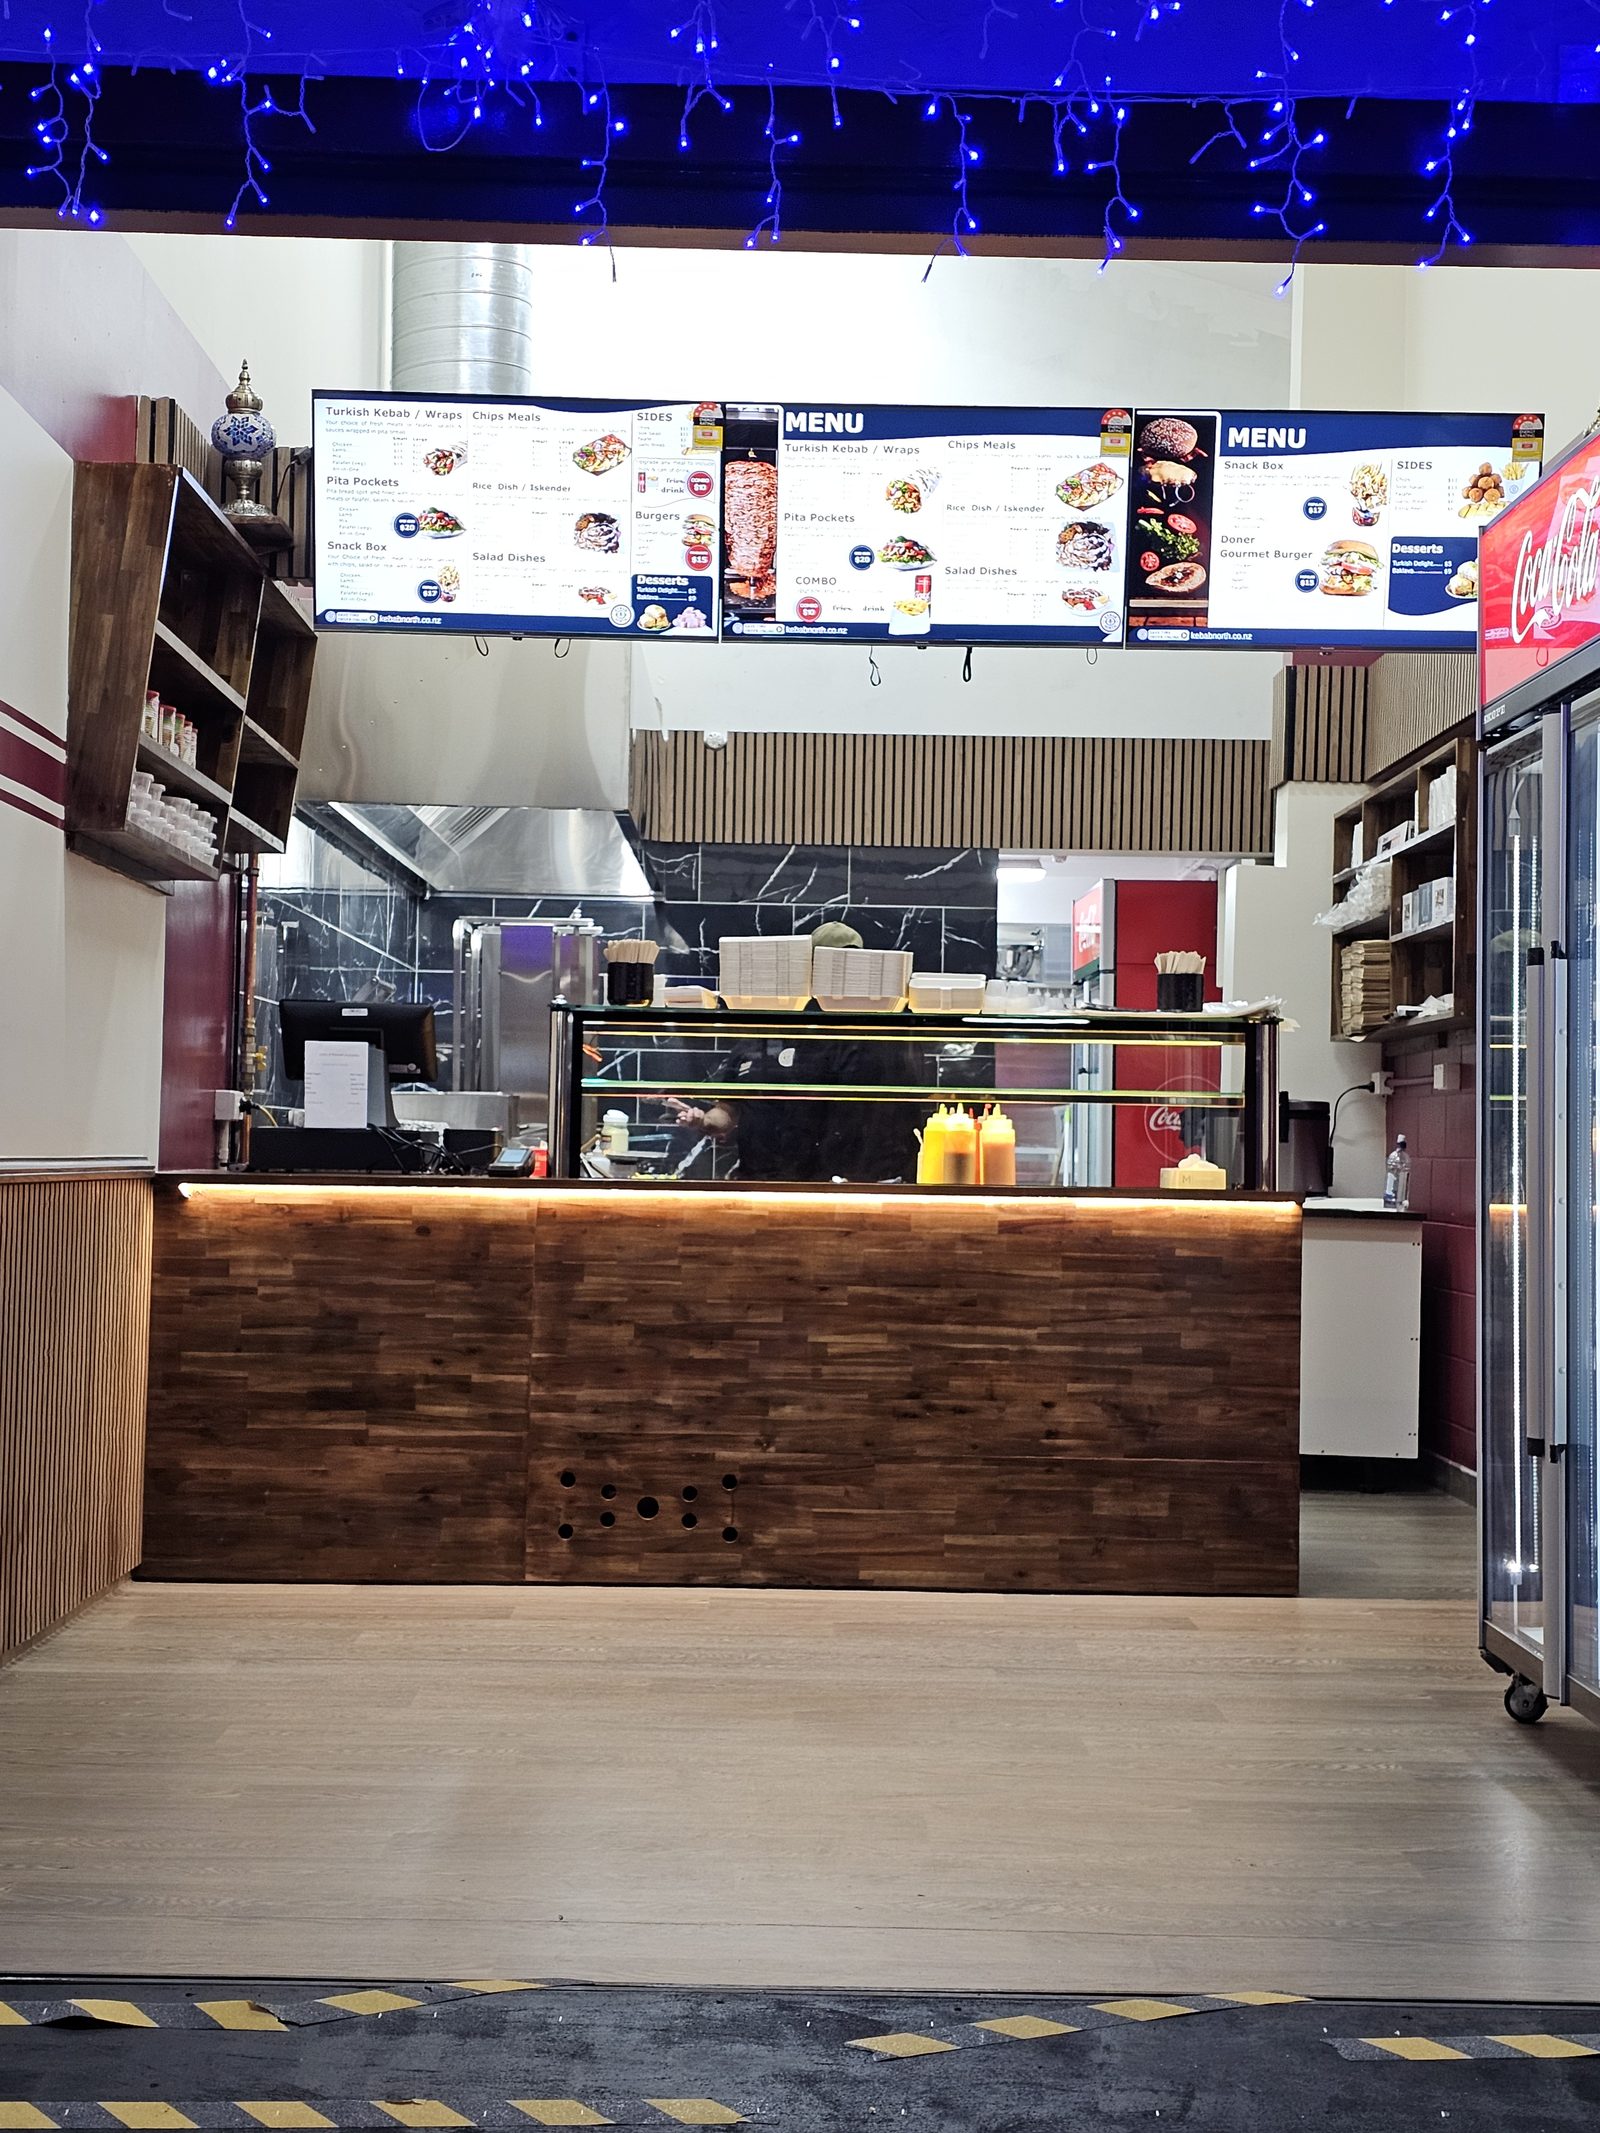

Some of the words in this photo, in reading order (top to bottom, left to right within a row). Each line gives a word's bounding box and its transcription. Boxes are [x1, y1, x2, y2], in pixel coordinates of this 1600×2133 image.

[326, 406, 369, 416] Turkish
[374, 408, 410, 418] Kebab
[425, 410, 462, 420] Wraps
[472, 411, 504, 422] Chips
[508, 412, 541, 422] Meals
[637, 412, 673, 422] SIDES
[786, 412, 864, 433] MENU
[1228, 428, 1307, 448] MENU
[784, 444, 828, 453] Turkish
[832, 444, 868, 454] Kebab
[883, 446, 920, 455] Wraps
[948, 440, 979, 450] Chips
[983, 440, 1016, 450] Meals
[1224, 461, 1258, 470] Snack
[1263, 462, 1284, 470] Box
[1397, 461, 1433, 470] SIDES
[327, 476, 349, 486] Pita
[353, 477, 399, 487] Pockets
[472, 482, 492, 490] Rice
[530, 484, 571, 492] Iskender
[946, 504, 966, 512] Rice
[972, 504, 992, 512] Dish
[1004, 505, 1044, 513] Iskender
[635, 511, 680, 521] Burgers
[784, 513, 806, 522] Pita
[810, 514, 855, 523] Pockets
[400, 524, 415, 532] $20
[1221, 535, 1256, 544] Doner
[327, 540, 362, 550] Snack
[366, 542, 387, 551] Box
[1392, 544, 1444, 554] Desserts
[472, 552, 504, 561] Salad
[508, 553, 546, 563] Dishes
[1220, 549, 1270, 558] Gourmet
[1274, 550, 1313, 560] Burger
[691, 556, 708, 564] $15
[855, 556, 870, 564] $20
[945, 566, 976, 575] Salad
[980, 566, 1018, 576] Dishes
[637, 575, 689, 585] Desserts
[795, 576, 837, 585] COMBO
[1191, 631, 1252, 640] kebabnorth.co.nz
